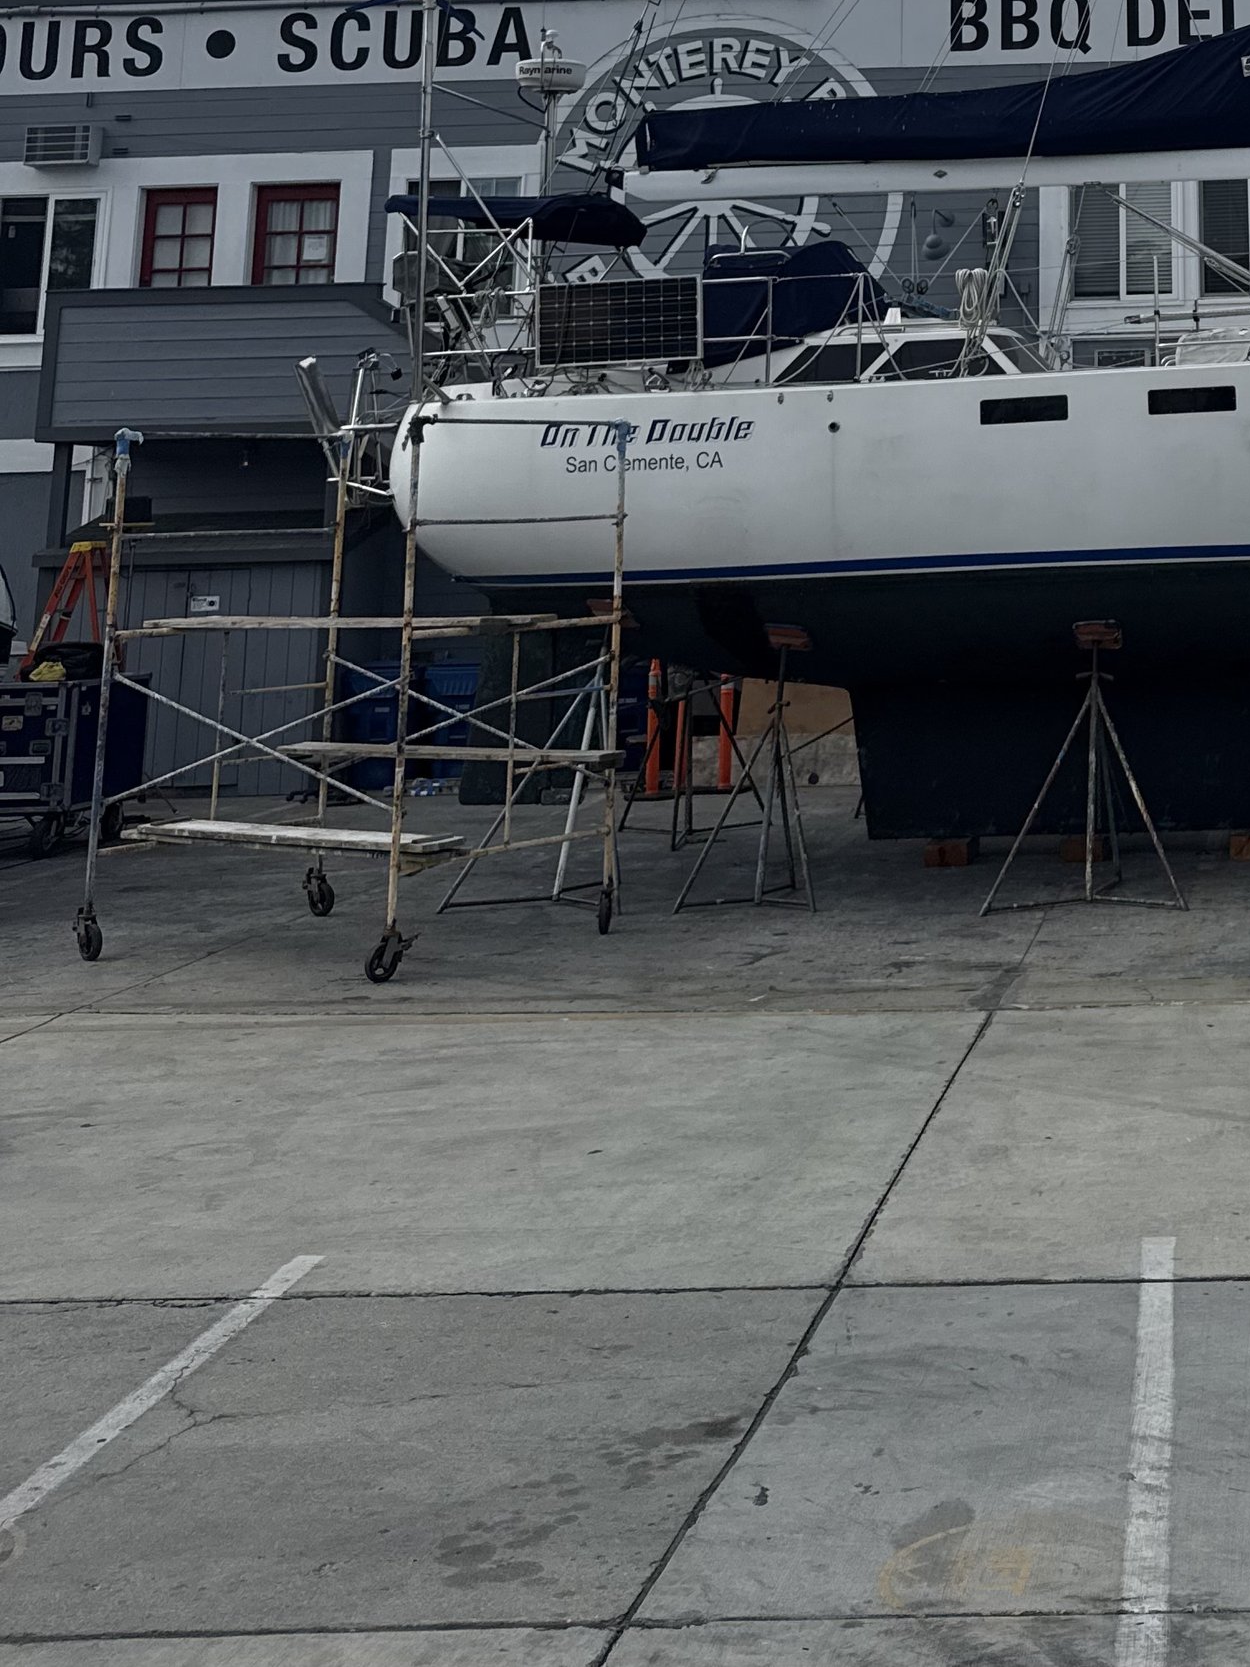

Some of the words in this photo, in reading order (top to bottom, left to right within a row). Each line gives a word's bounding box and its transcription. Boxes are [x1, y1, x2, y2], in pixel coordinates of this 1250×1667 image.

[0, 16, 164, 80] URS
[277, 6, 532, 72] SCUBA
[556, 37, 811, 176] MONTEREY
[645, 416, 754, 445] Double
[566, 456, 598, 474] San
[603, 454, 689, 473] Cemente,
[696, 451, 724, 469] CA
